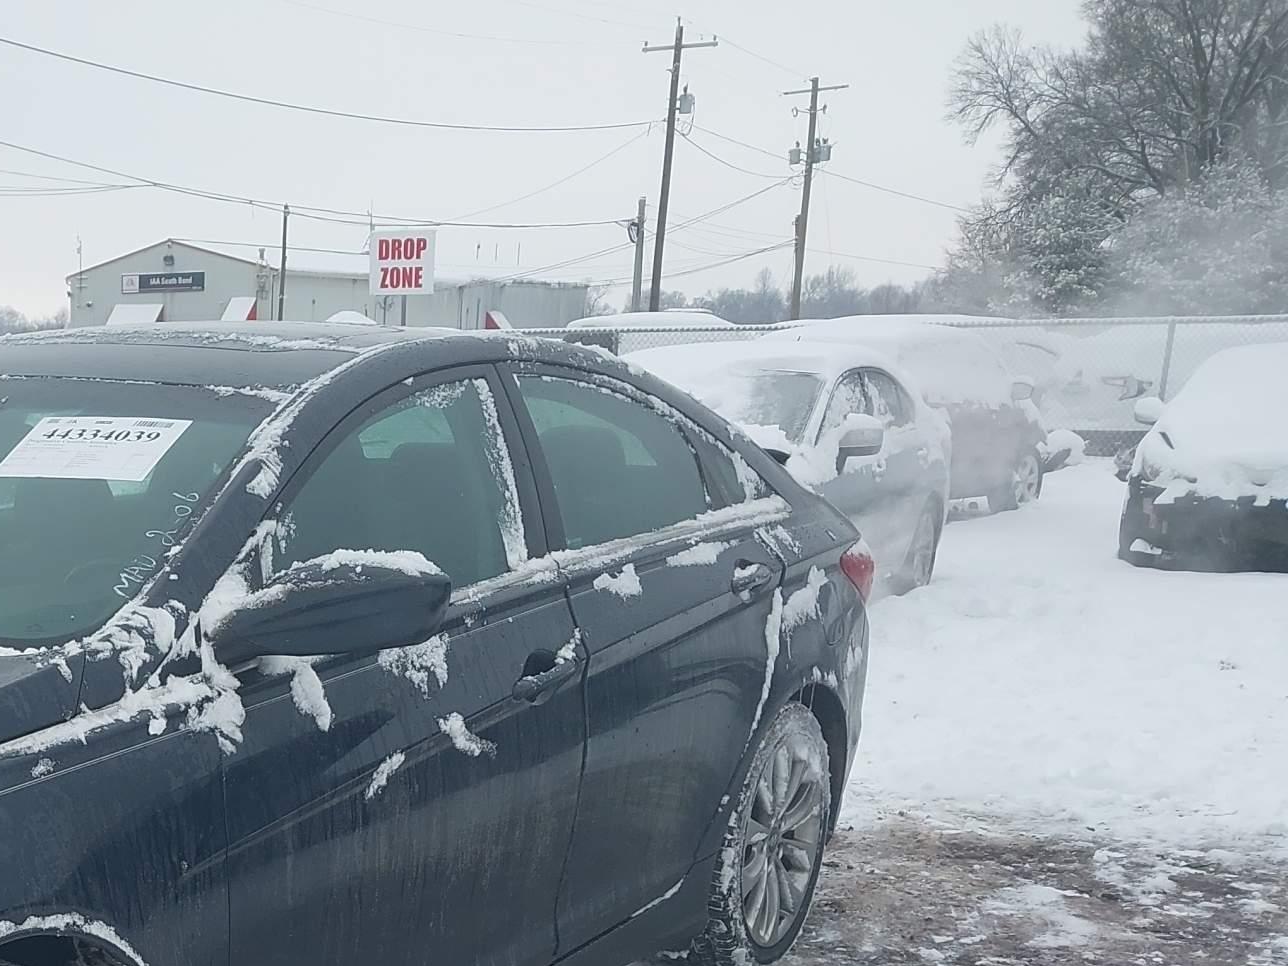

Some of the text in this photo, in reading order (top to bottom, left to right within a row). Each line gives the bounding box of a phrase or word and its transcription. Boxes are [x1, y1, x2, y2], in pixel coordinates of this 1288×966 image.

[378, 237, 427, 260] DROP
[379, 266, 423, 289] ZONE
[42, 427, 161, 443] 44334039
